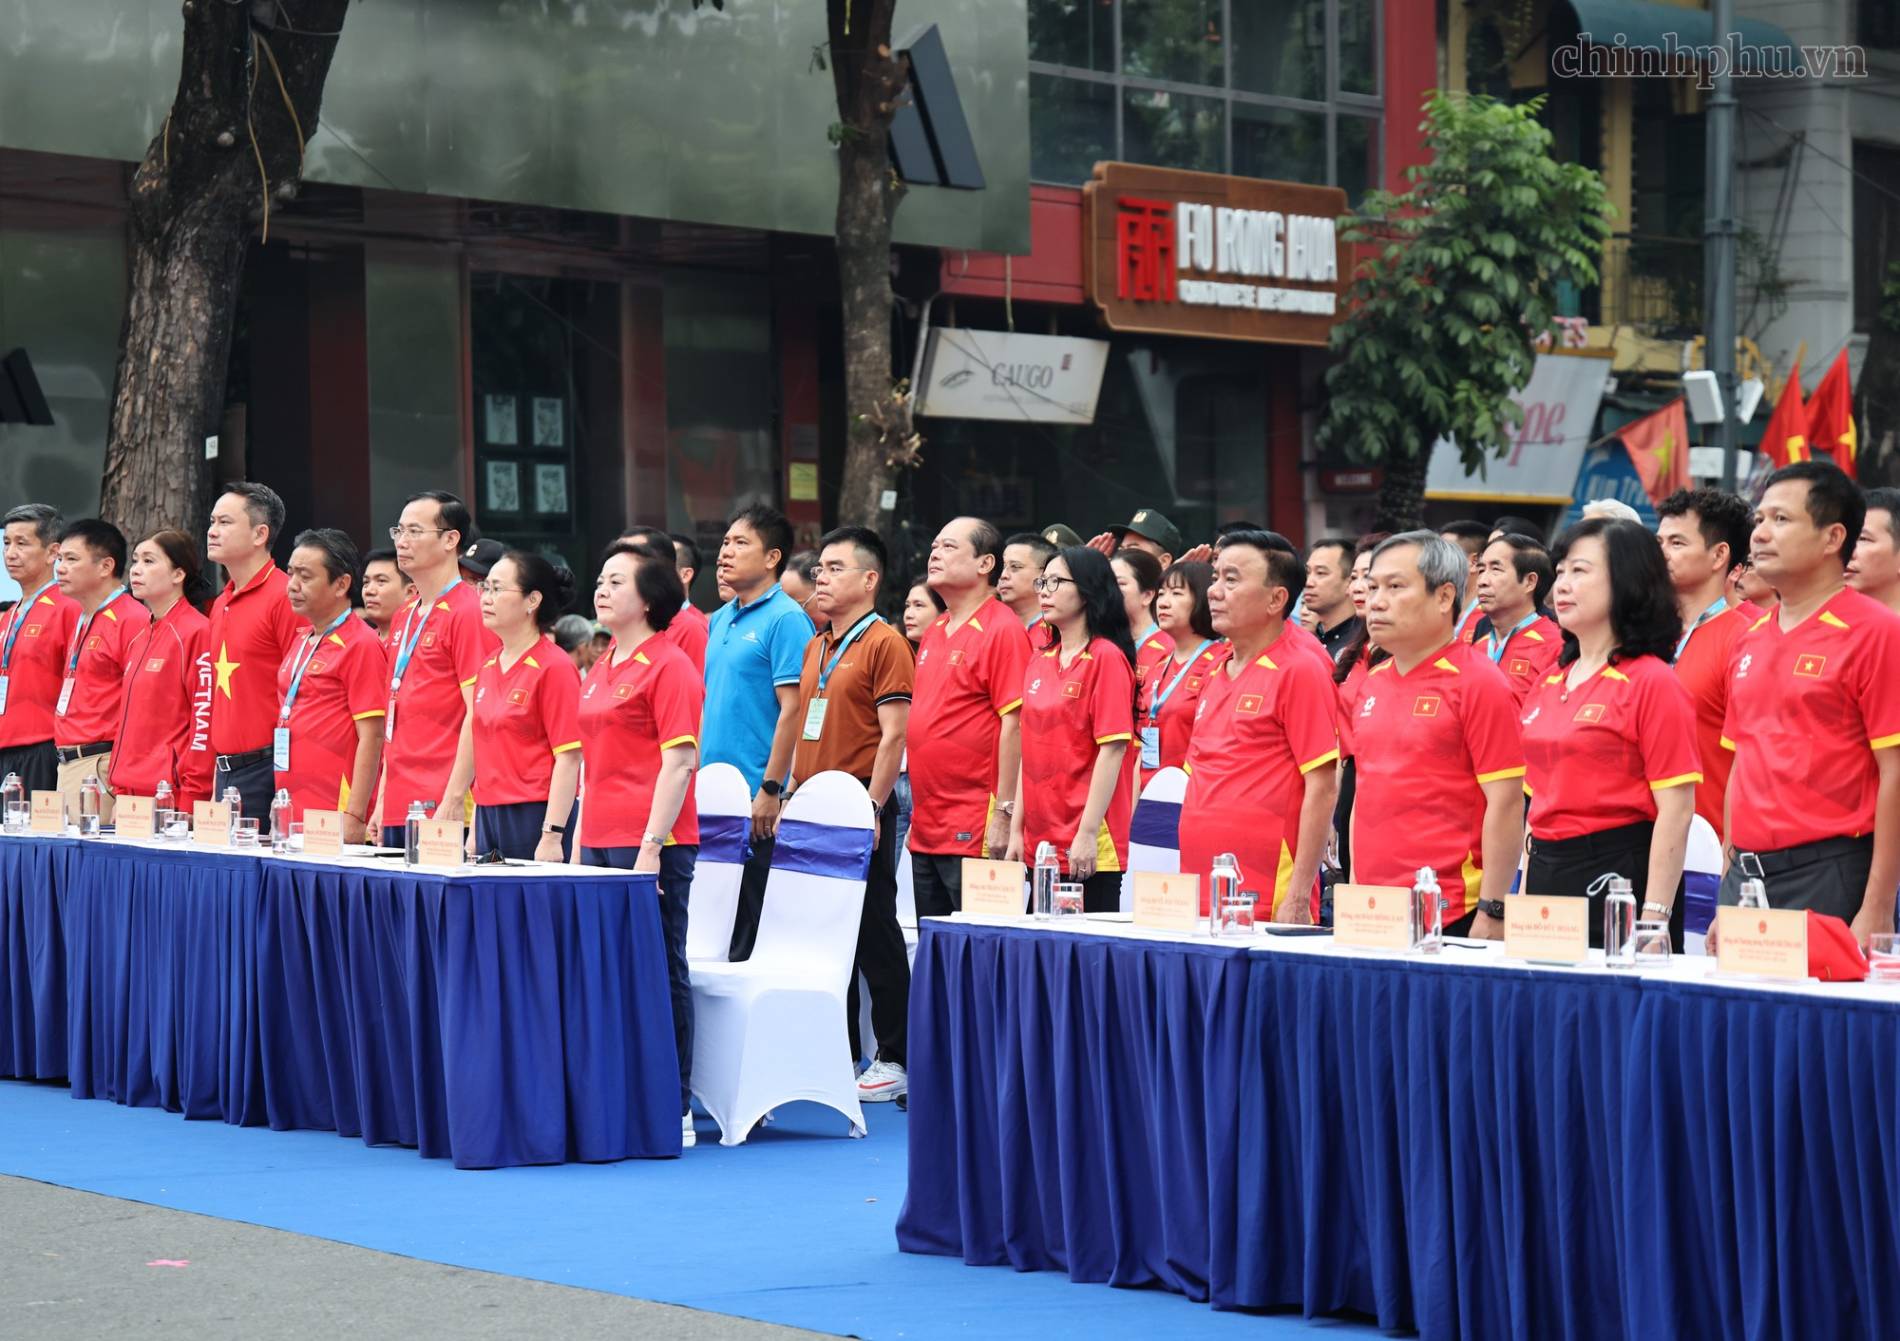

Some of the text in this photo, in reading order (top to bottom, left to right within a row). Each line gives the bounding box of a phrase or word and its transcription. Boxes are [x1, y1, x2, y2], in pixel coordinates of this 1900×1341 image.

[1177, 201, 1213, 272] FU
[1215, 206, 1285, 278] RONG
[1286, 213, 1338, 282] HUA
[190, 651, 213, 752] VIETNAM
